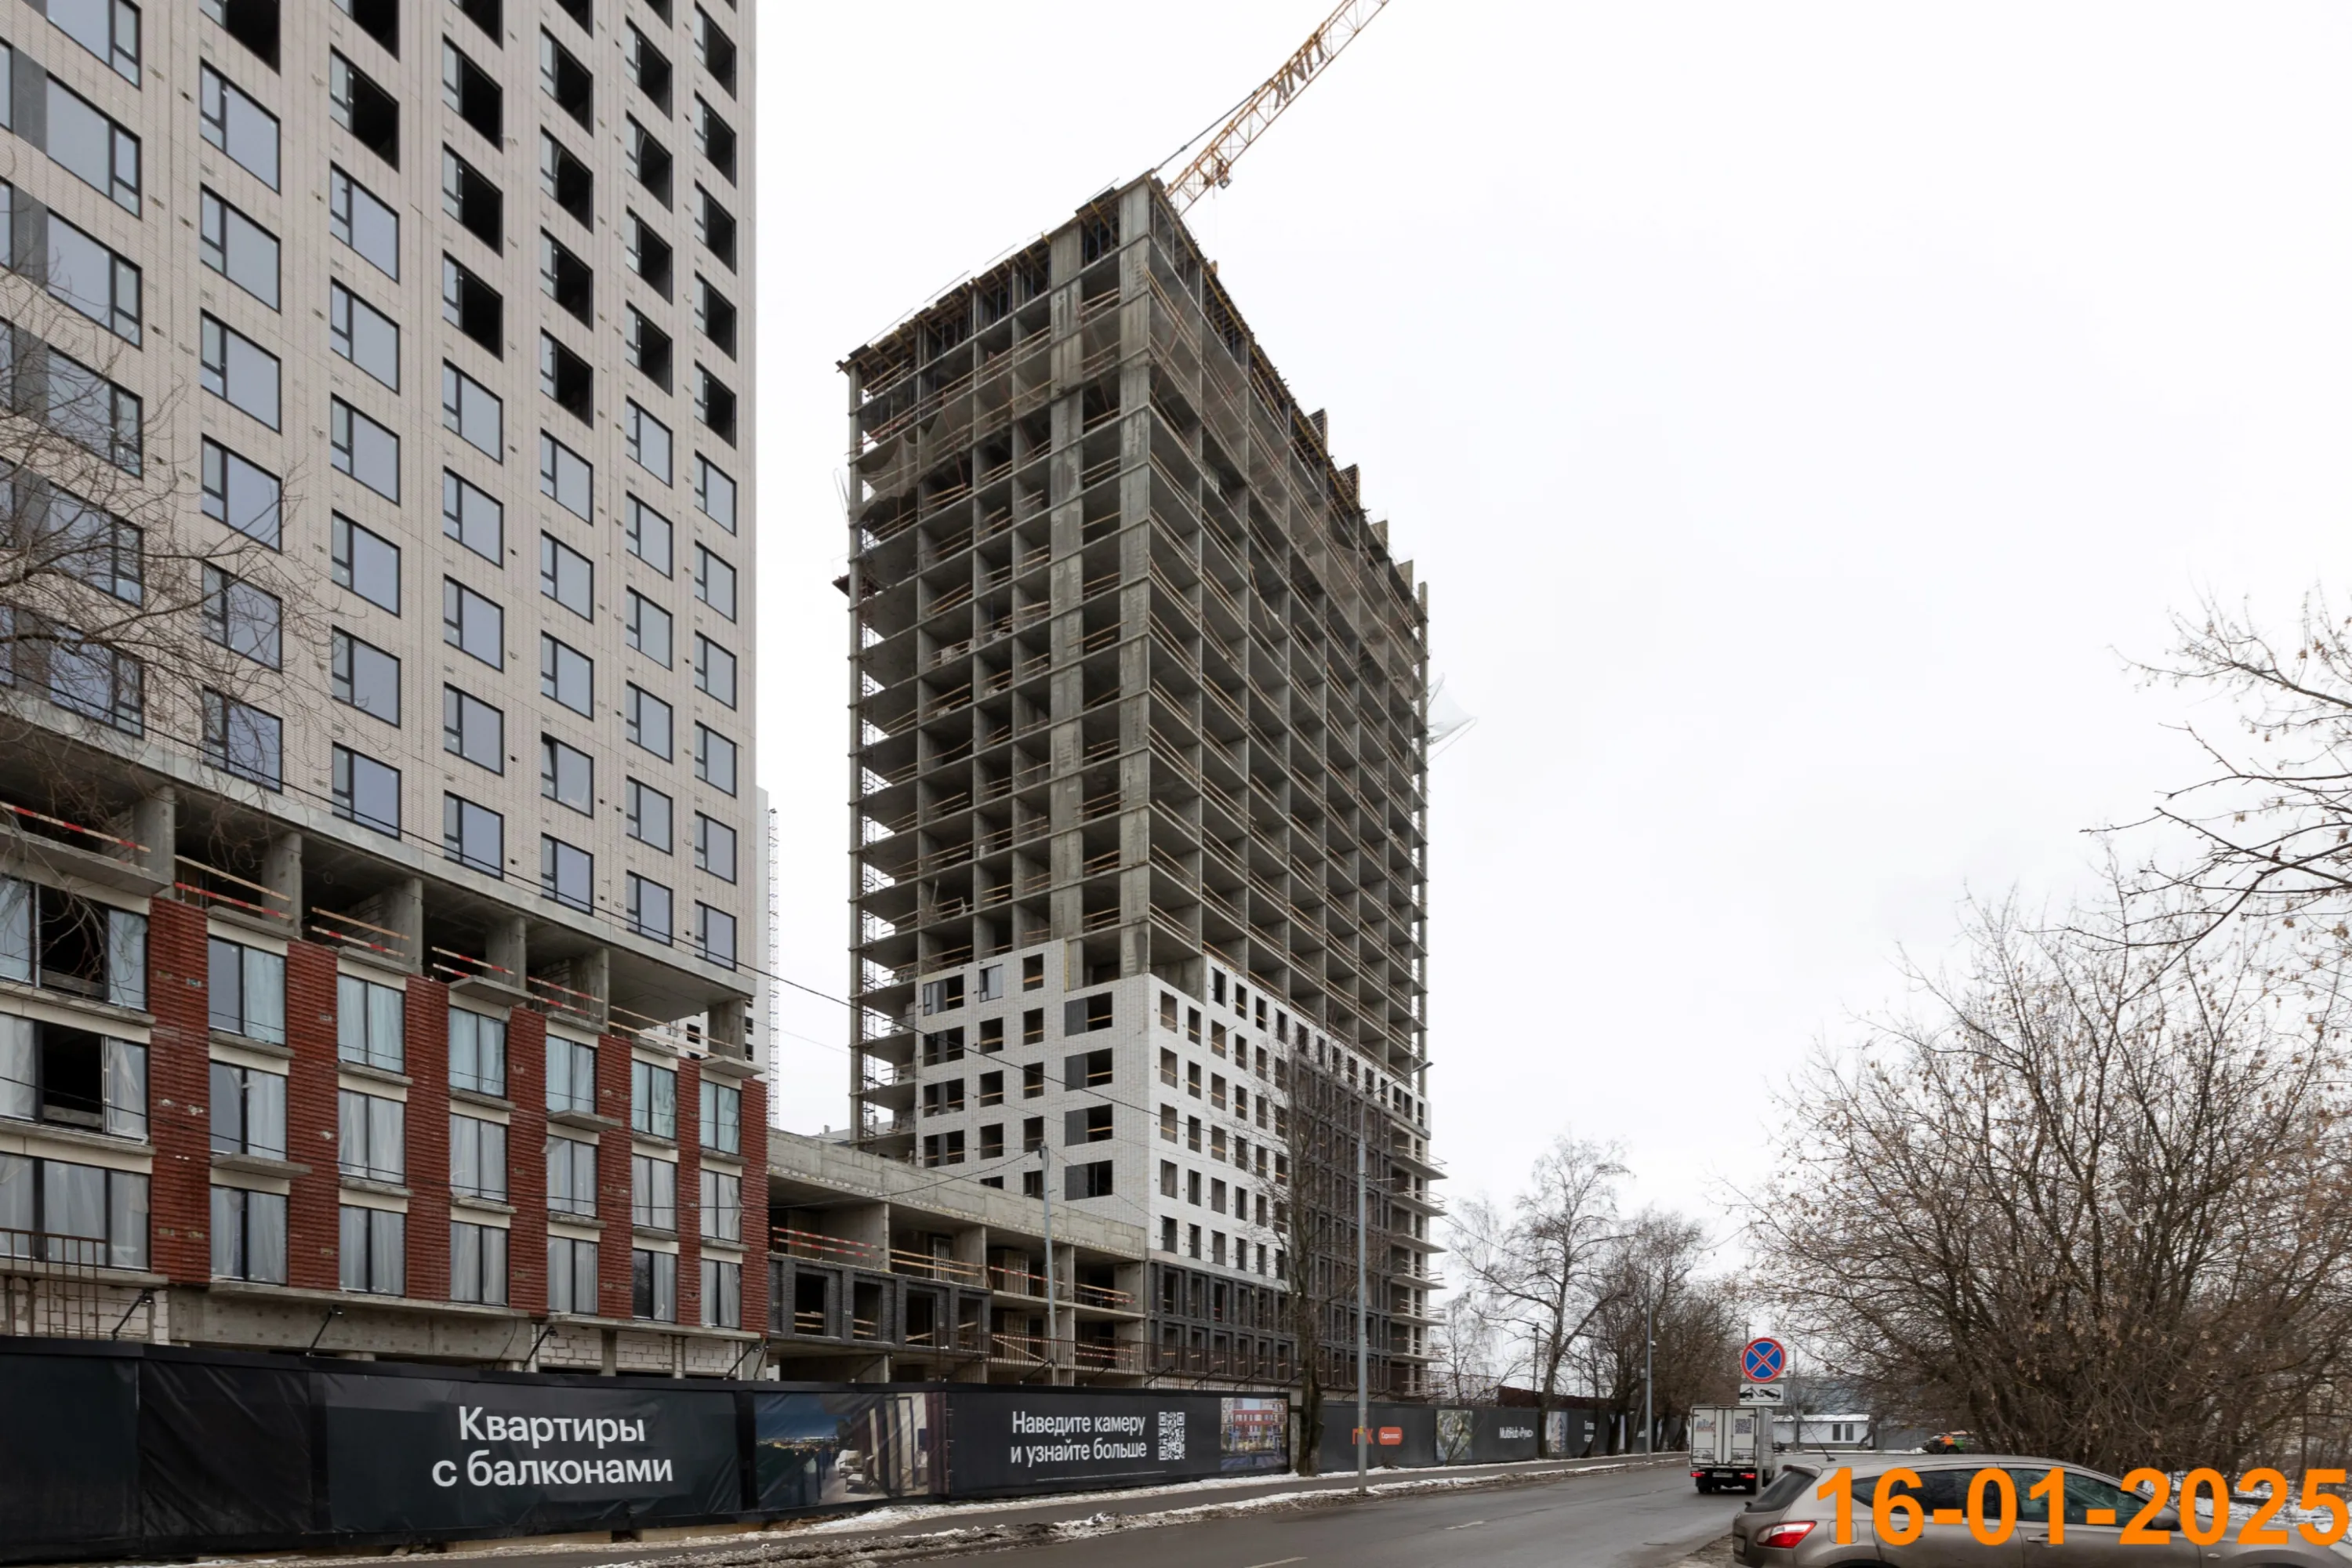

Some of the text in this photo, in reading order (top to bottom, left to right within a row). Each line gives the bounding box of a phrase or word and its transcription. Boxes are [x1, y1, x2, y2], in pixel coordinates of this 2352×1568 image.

[459, 1406, 645, 1449] Квартиры
[1013, 1411, 1146, 1436] Наведите камеру
[432, 1450, 673, 1486] с балконами
[1011, 1437, 1147, 1468] и узнайте больше
